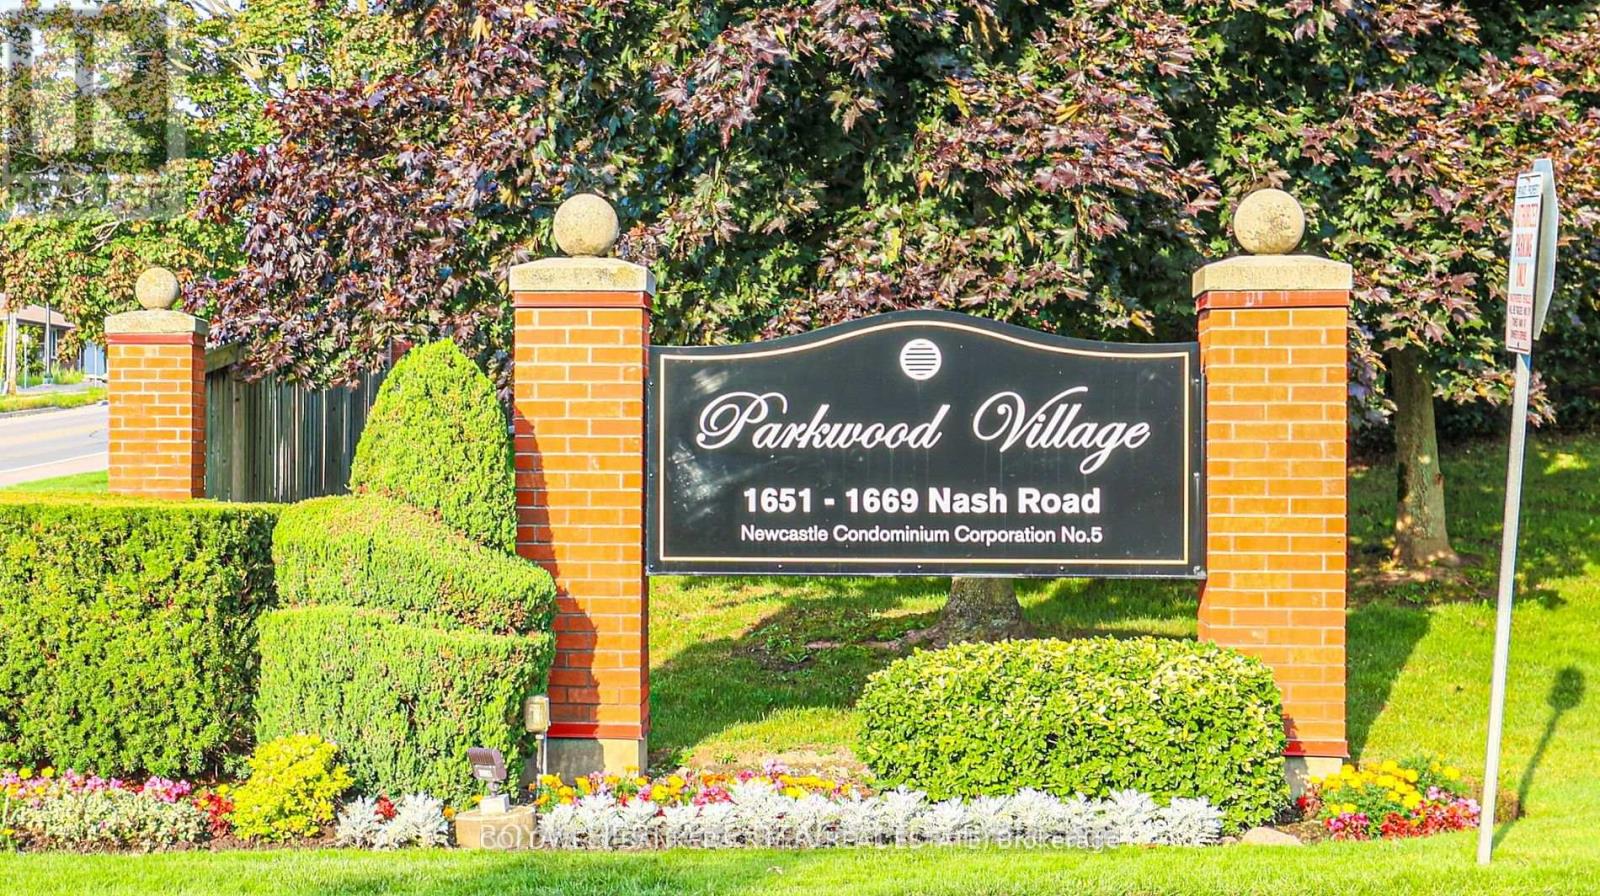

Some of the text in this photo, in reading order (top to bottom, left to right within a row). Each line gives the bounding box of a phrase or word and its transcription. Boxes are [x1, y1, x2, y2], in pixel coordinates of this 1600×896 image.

[696, 386, 1151, 475] Parkwood Village
[743, 487, 811, 514] 1651
[846, 487, 919, 514] 1669
[929, 487, 1007, 514] Nash
[1018, 487, 1101, 514] Road
[741, 525, 1104, 547] Newcastle Condominium Corporation No.5
